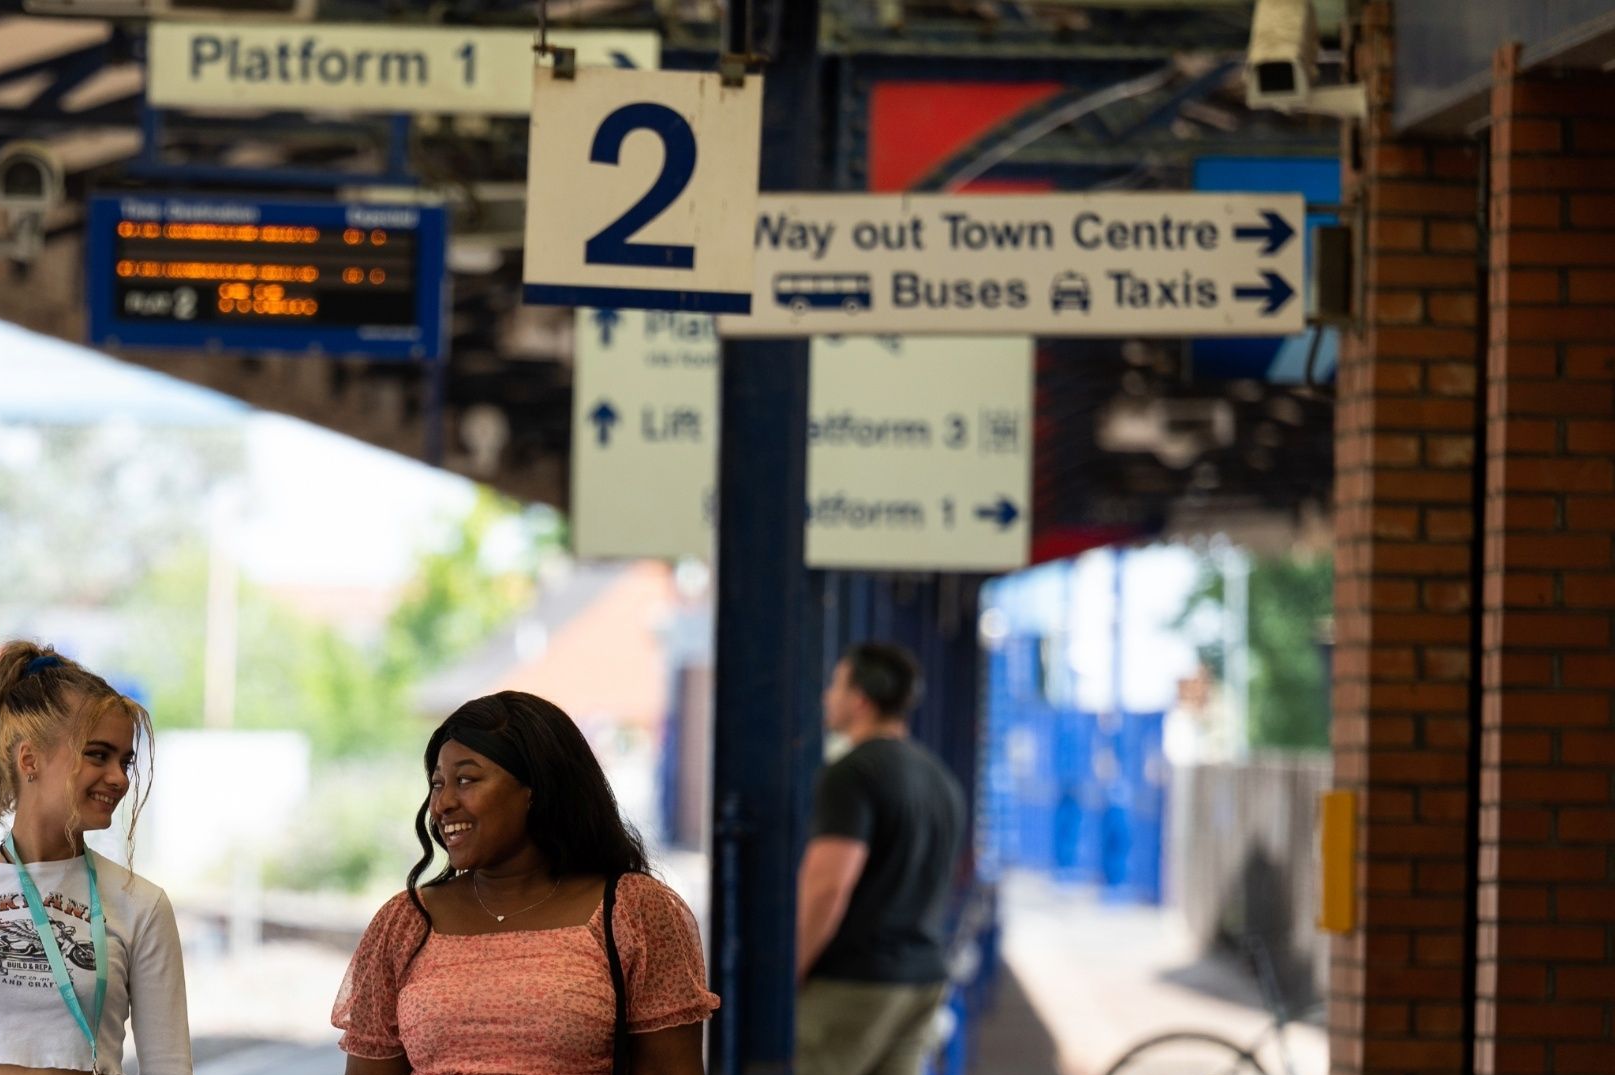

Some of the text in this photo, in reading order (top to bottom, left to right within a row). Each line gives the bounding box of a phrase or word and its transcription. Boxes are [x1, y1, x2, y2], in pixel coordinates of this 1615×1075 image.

[189, 35, 477, 86] Platform 1
[584, 102, 697, 270] 2
[851, 215, 925, 252] out
[940, 213, 1055, 252] Town
[1072, 213, 1220, 253] Centre
[891, 271, 1219, 310] Buses Taxis
[641, 405, 703, 443] Lift
[939, 497, 957, 530] 1
[6, 961, 27, 970] BUILD
